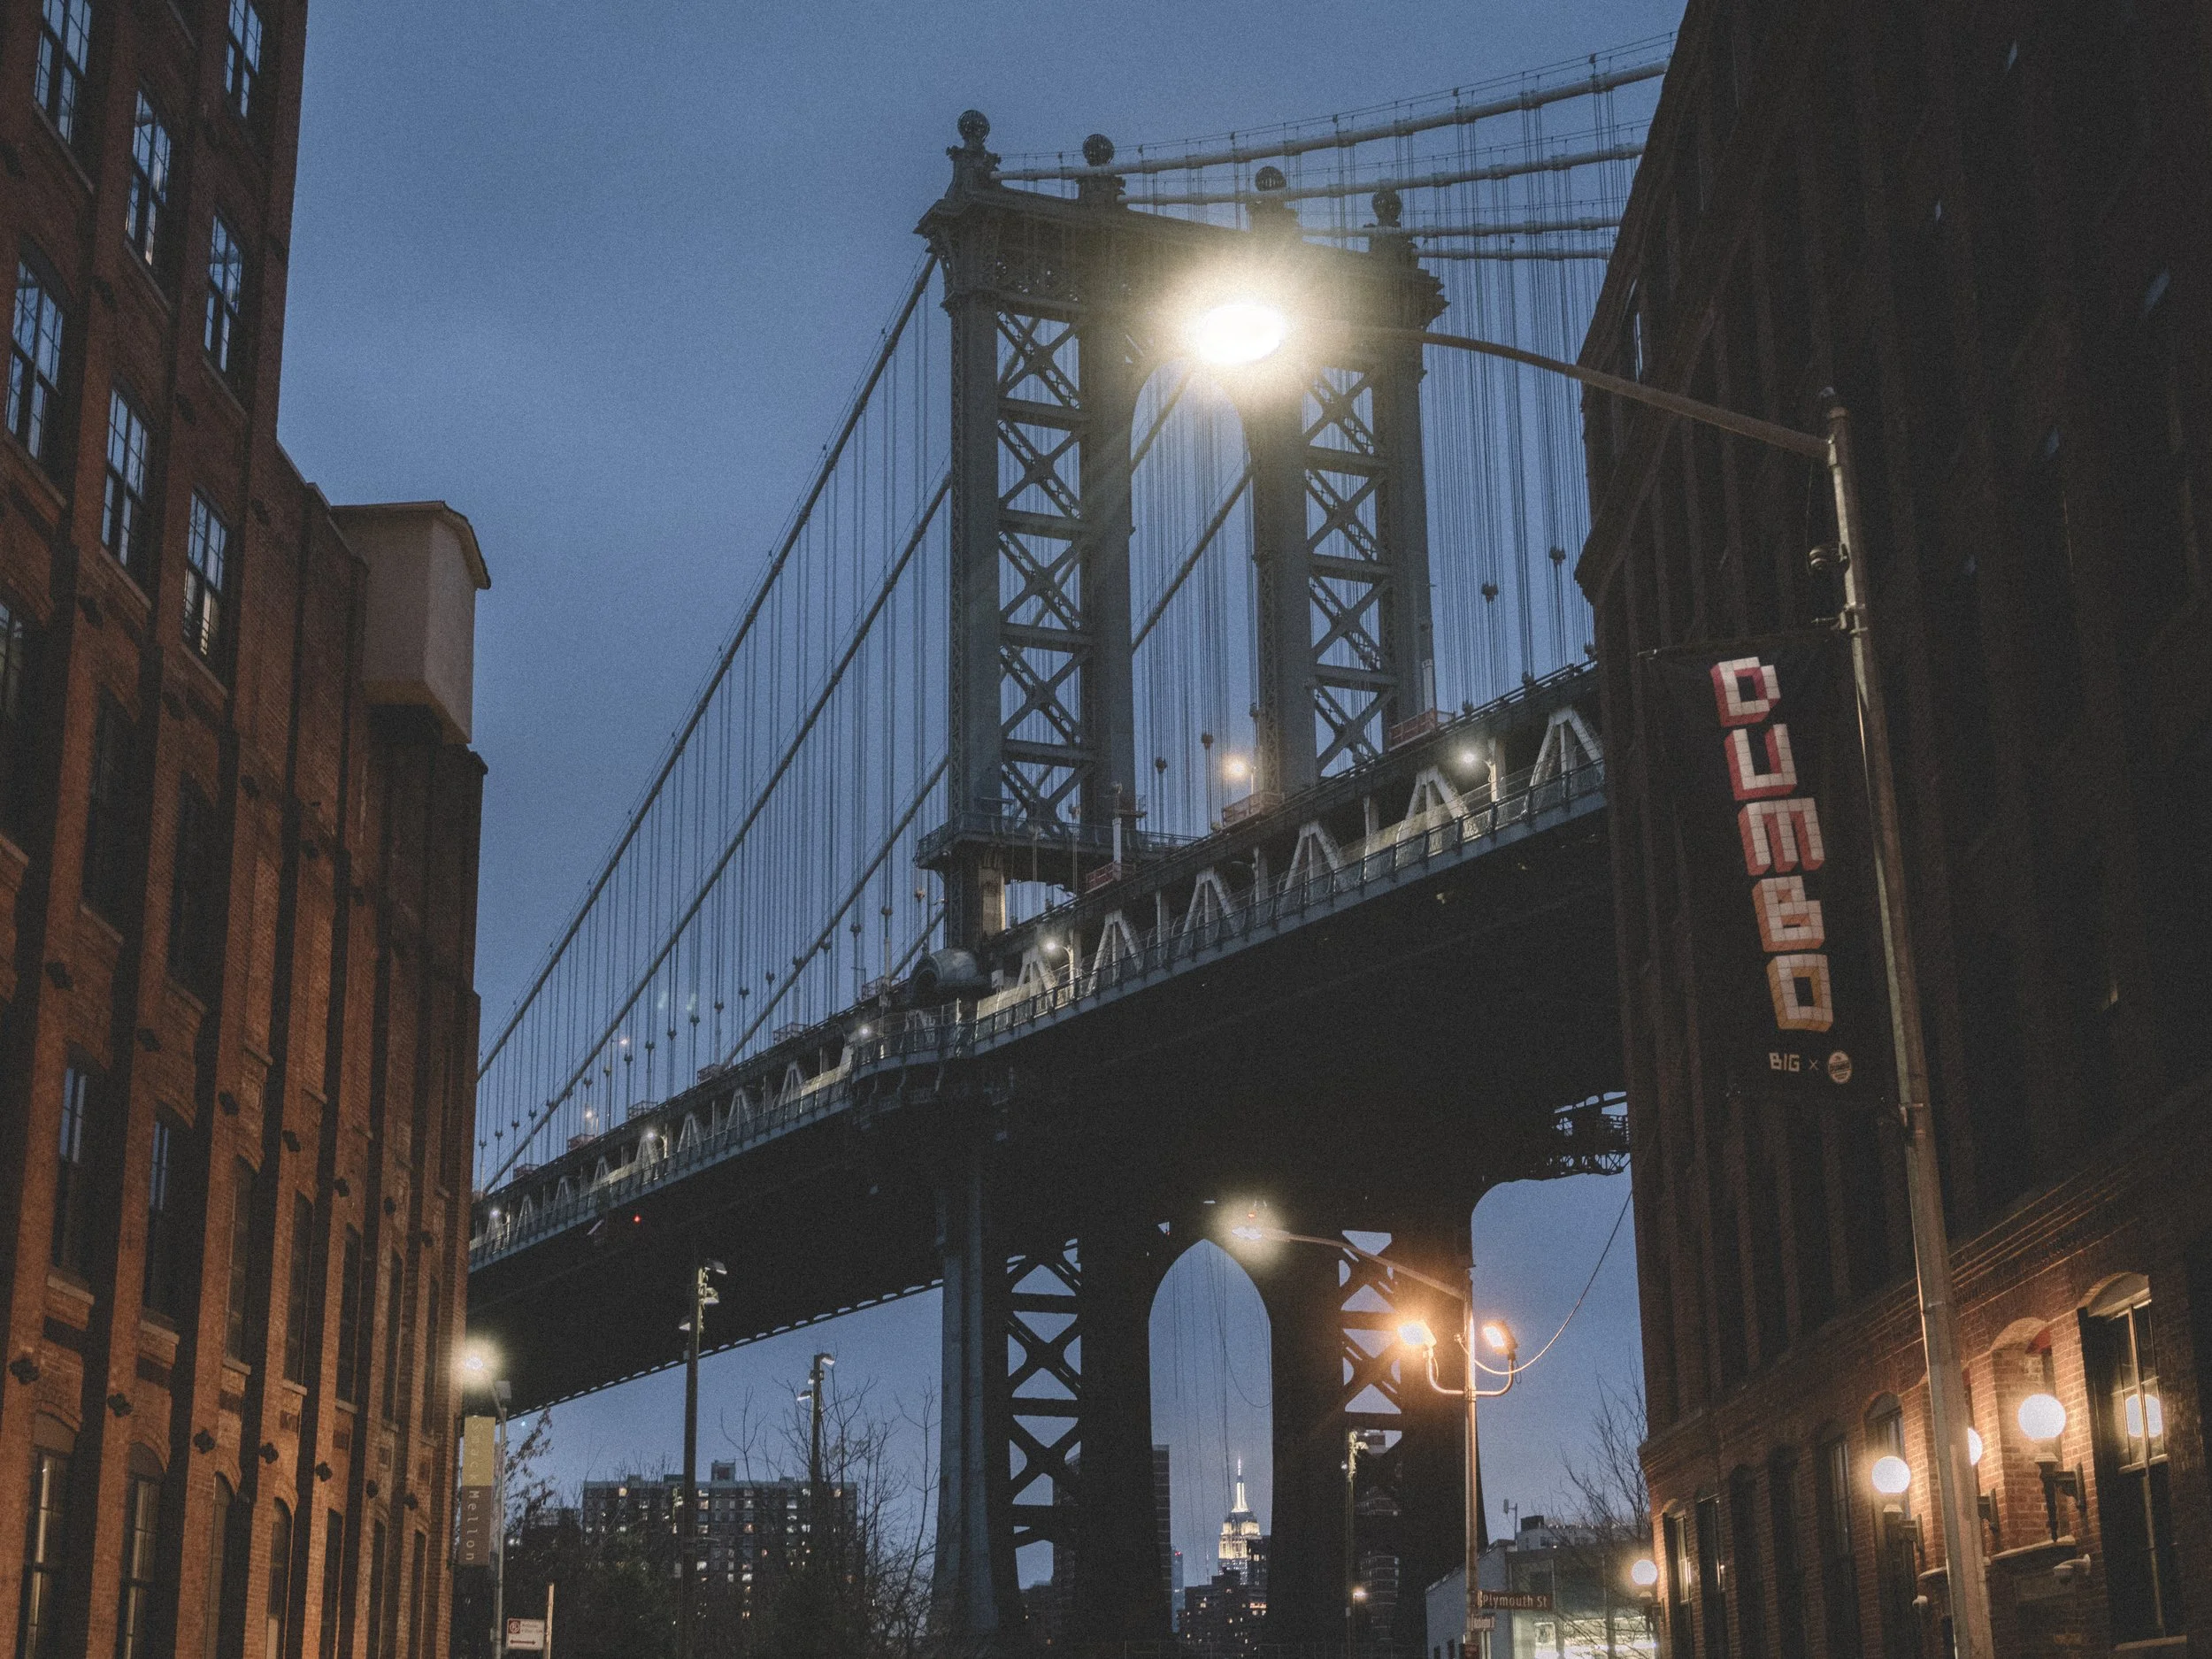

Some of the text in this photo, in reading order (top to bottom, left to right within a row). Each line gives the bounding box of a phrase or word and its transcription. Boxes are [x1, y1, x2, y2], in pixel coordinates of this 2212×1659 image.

[1710, 657, 1833, 1032] DUMBO
[1769, 1052, 1800, 1072] BIG
[465, 1490, 480, 1561] Mellon
[1483, 1594, 1548, 1609] Plymouth St
